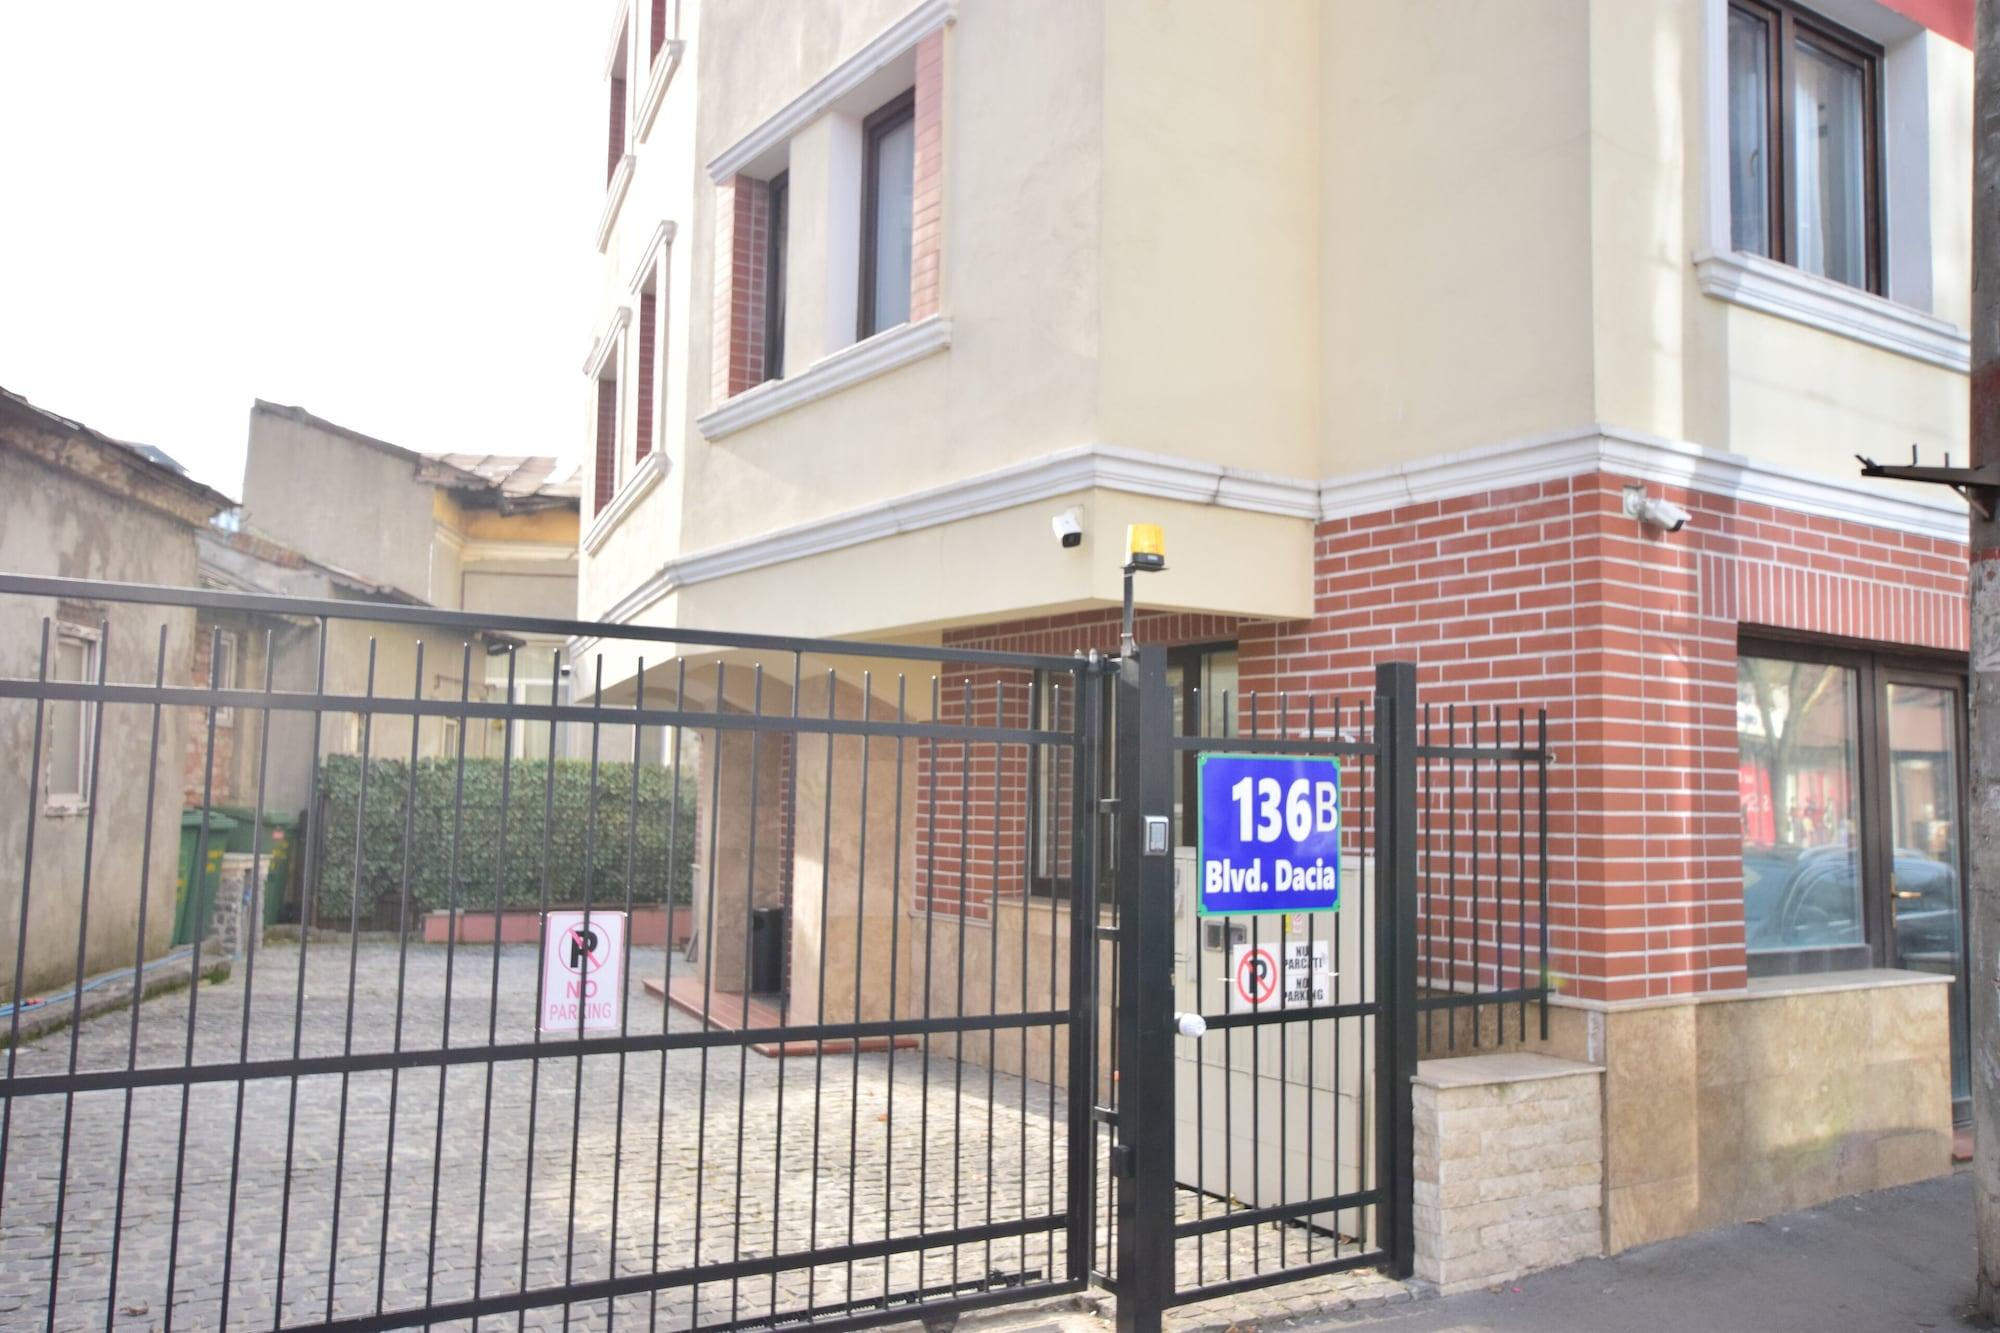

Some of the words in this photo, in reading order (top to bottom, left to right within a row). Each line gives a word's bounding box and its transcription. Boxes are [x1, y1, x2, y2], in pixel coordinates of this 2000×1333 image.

[1232, 777, 1338, 843] 136B
[1205, 858, 1269, 893] Blvd.
[1275, 857, 1335, 892] Dacia
[567, 980, 597, 999] NO
